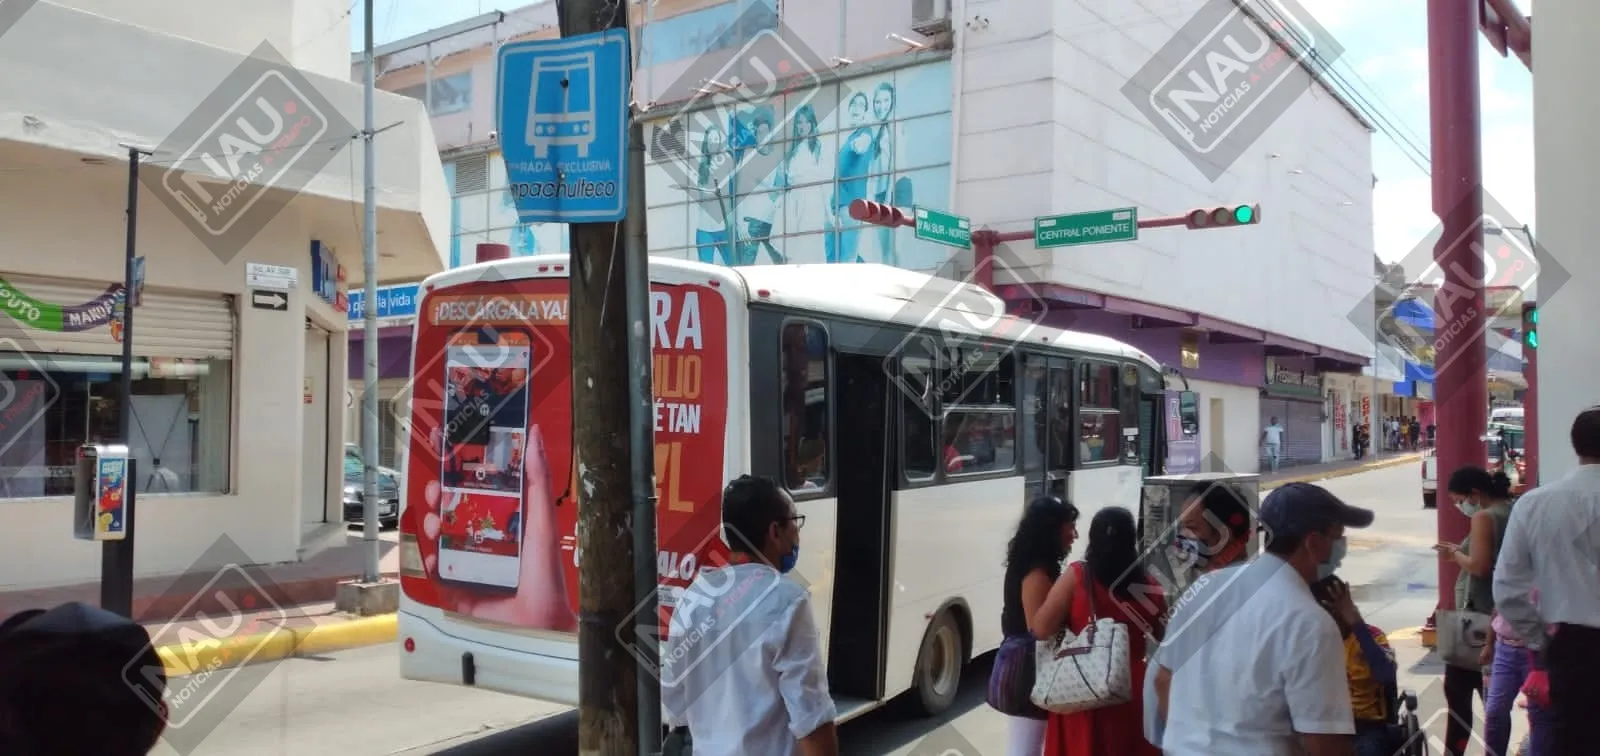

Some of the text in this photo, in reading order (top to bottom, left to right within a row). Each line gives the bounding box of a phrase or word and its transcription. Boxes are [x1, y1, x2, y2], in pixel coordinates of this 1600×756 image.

[1040, 223, 1129, 240] CENTRAL PONIENTE
[391, 292, 410, 308] vida
[434, 296, 569, 326] ¡DESCÁRGALA YA!
[667, 403, 700, 434] TAN
